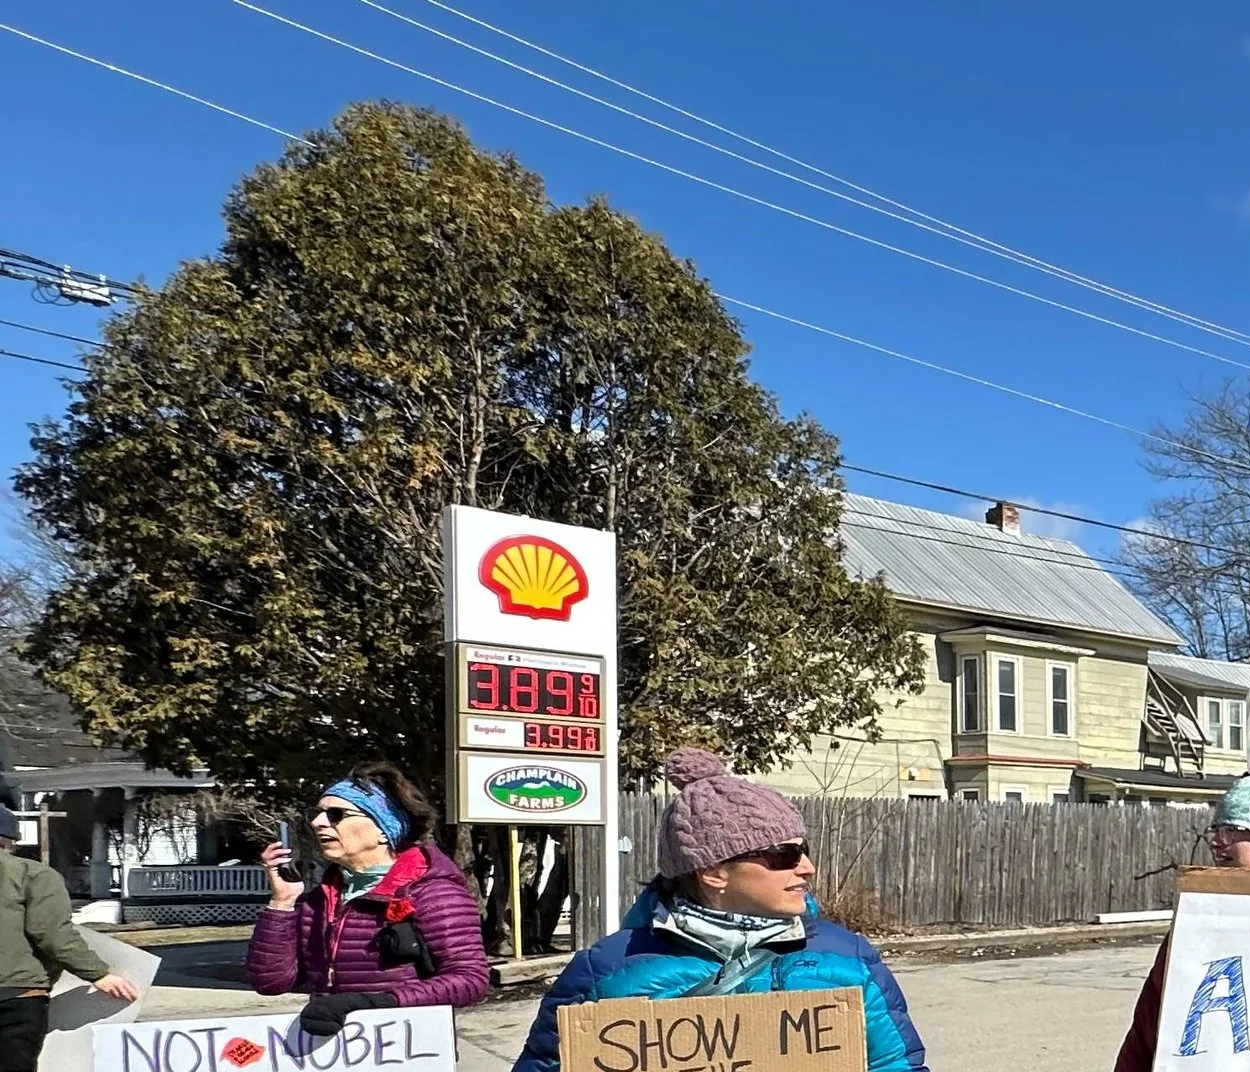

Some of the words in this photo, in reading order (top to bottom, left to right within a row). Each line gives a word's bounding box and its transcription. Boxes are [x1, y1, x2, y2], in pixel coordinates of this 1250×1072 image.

[495, 768, 577, 790] CHAMPLAIN
[509, 794, 565, 809] FARMS
[780, 1005, 841, 1054] ME
